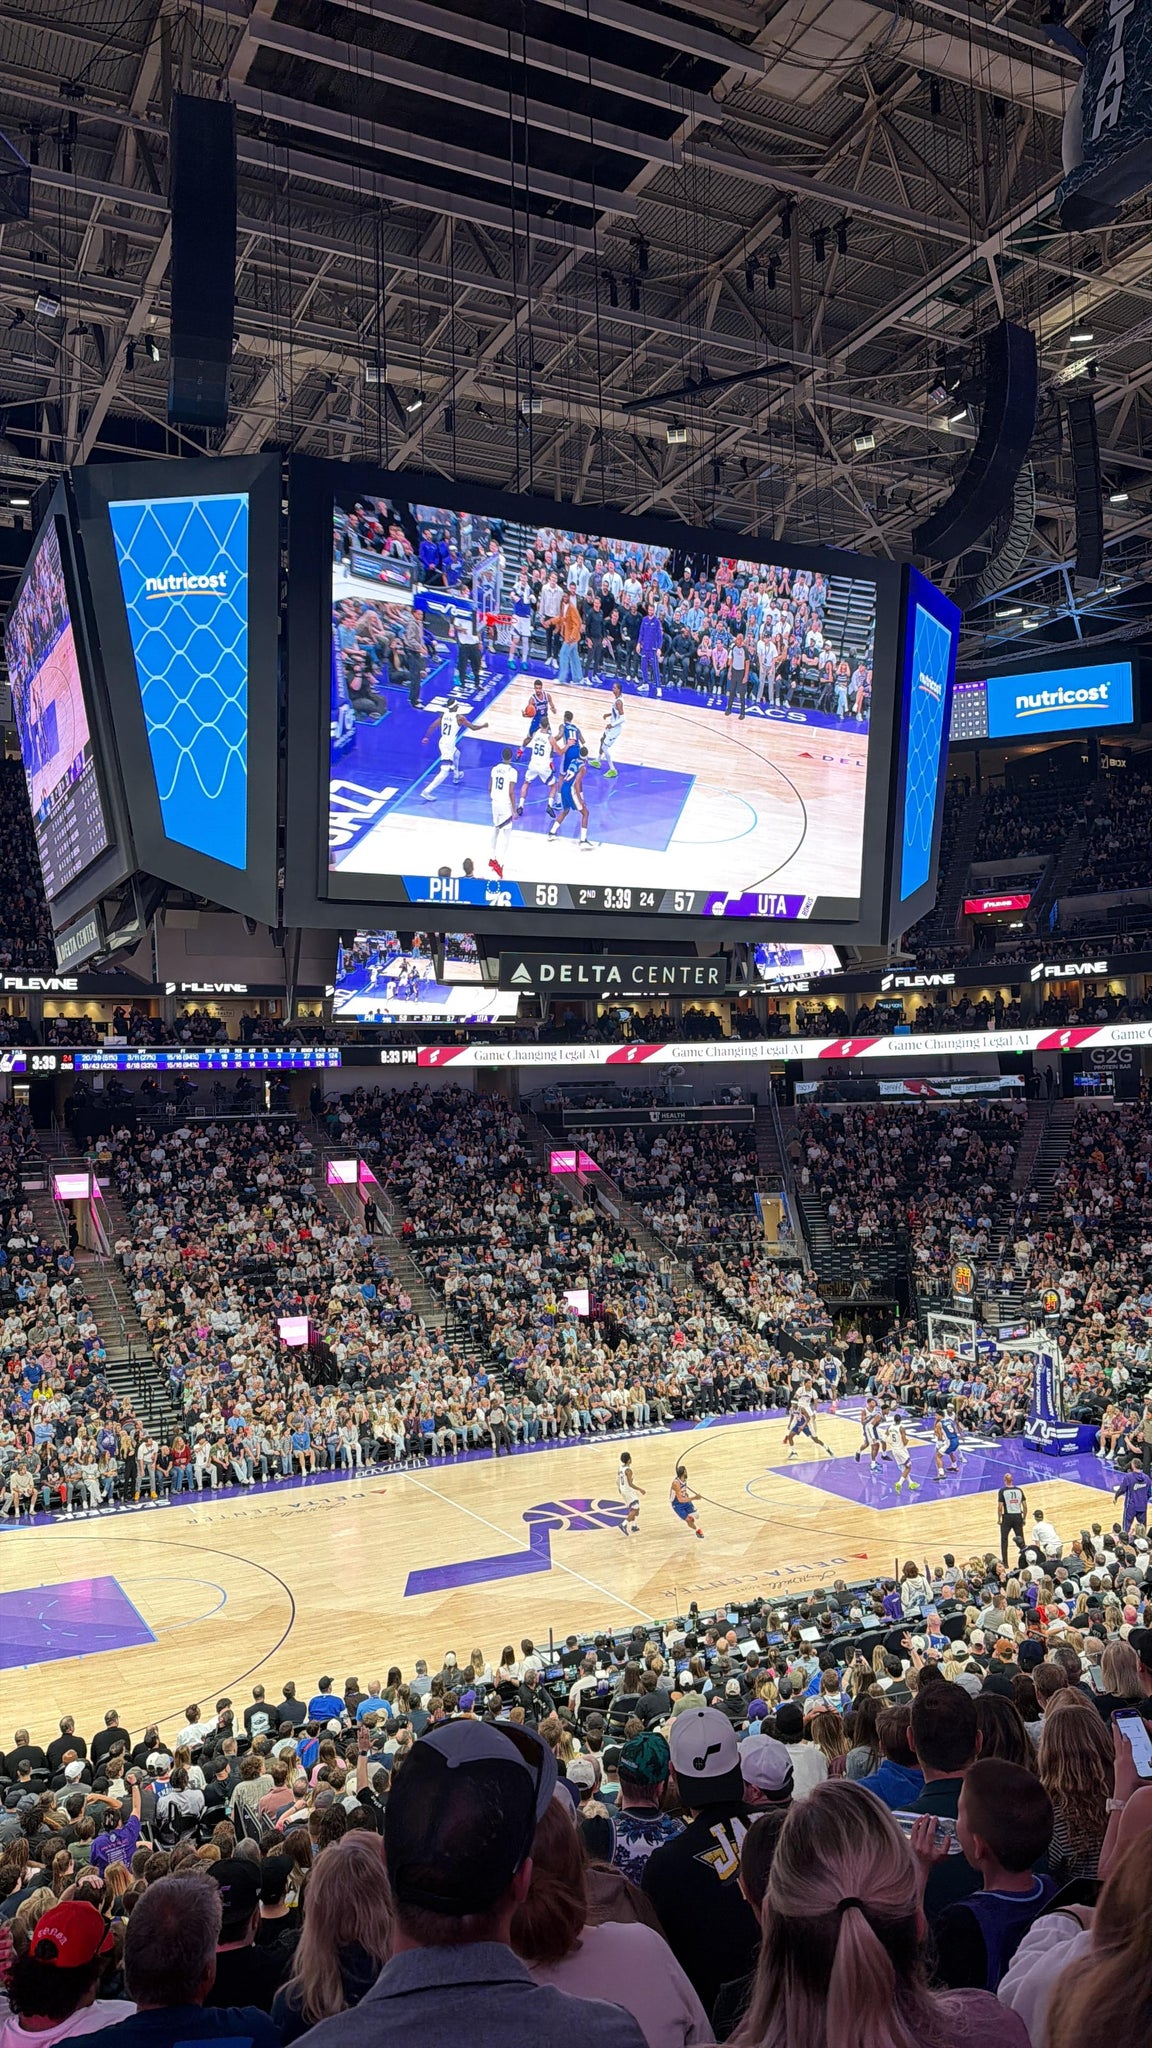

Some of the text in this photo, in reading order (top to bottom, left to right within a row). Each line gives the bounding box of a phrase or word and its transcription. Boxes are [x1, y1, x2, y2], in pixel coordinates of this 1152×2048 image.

[145, 571, 227, 592] nutricost
[1016, 683, 1109, 710] nutricost
[534, 744, 545, 757] 55
[496, 776, 504, 790] 19
[429, 878, 460, 900] PHI
[536, 885, 558, 906] 58
[579, 888, 655, 909] 2ND 3:39 24
[674, 892, 695, 912] 57
[758, 894, 787, 915] UTA
[540, 964, 720, 985] DELTA CENTER
[1045, 961, 1108, 978] FILEVINE
[4, 977, 78, 991] FILEVINE
[895, 973, 955, 988] FILEVINE
[888, 1034, 1029, 1052] Game Changing Legal AI
[1112, 1029, 1146, 1041] Game
[380, 1050, 416, 1064] 8:33 PM
[474, 1048, 600, 1062] Game Changing Legal AI
[672, 1044, 804, 1060] Game Changing Legal AI
[1090, 1047, 1133, 1064] G2G
[32, 1055, 56, 1070] 3:39
[60, 1062, 74, 1070] 2ND
[954, 1276, 971, 1294] 24
[1046, 1302, 1056, 1312] 24
[53, 1499, 171, 1522] SEATGEEK
[188, 1493, 366, 1525] DELTA CENTER
[661, 1557, 849, 1598] DELTA CENTER
